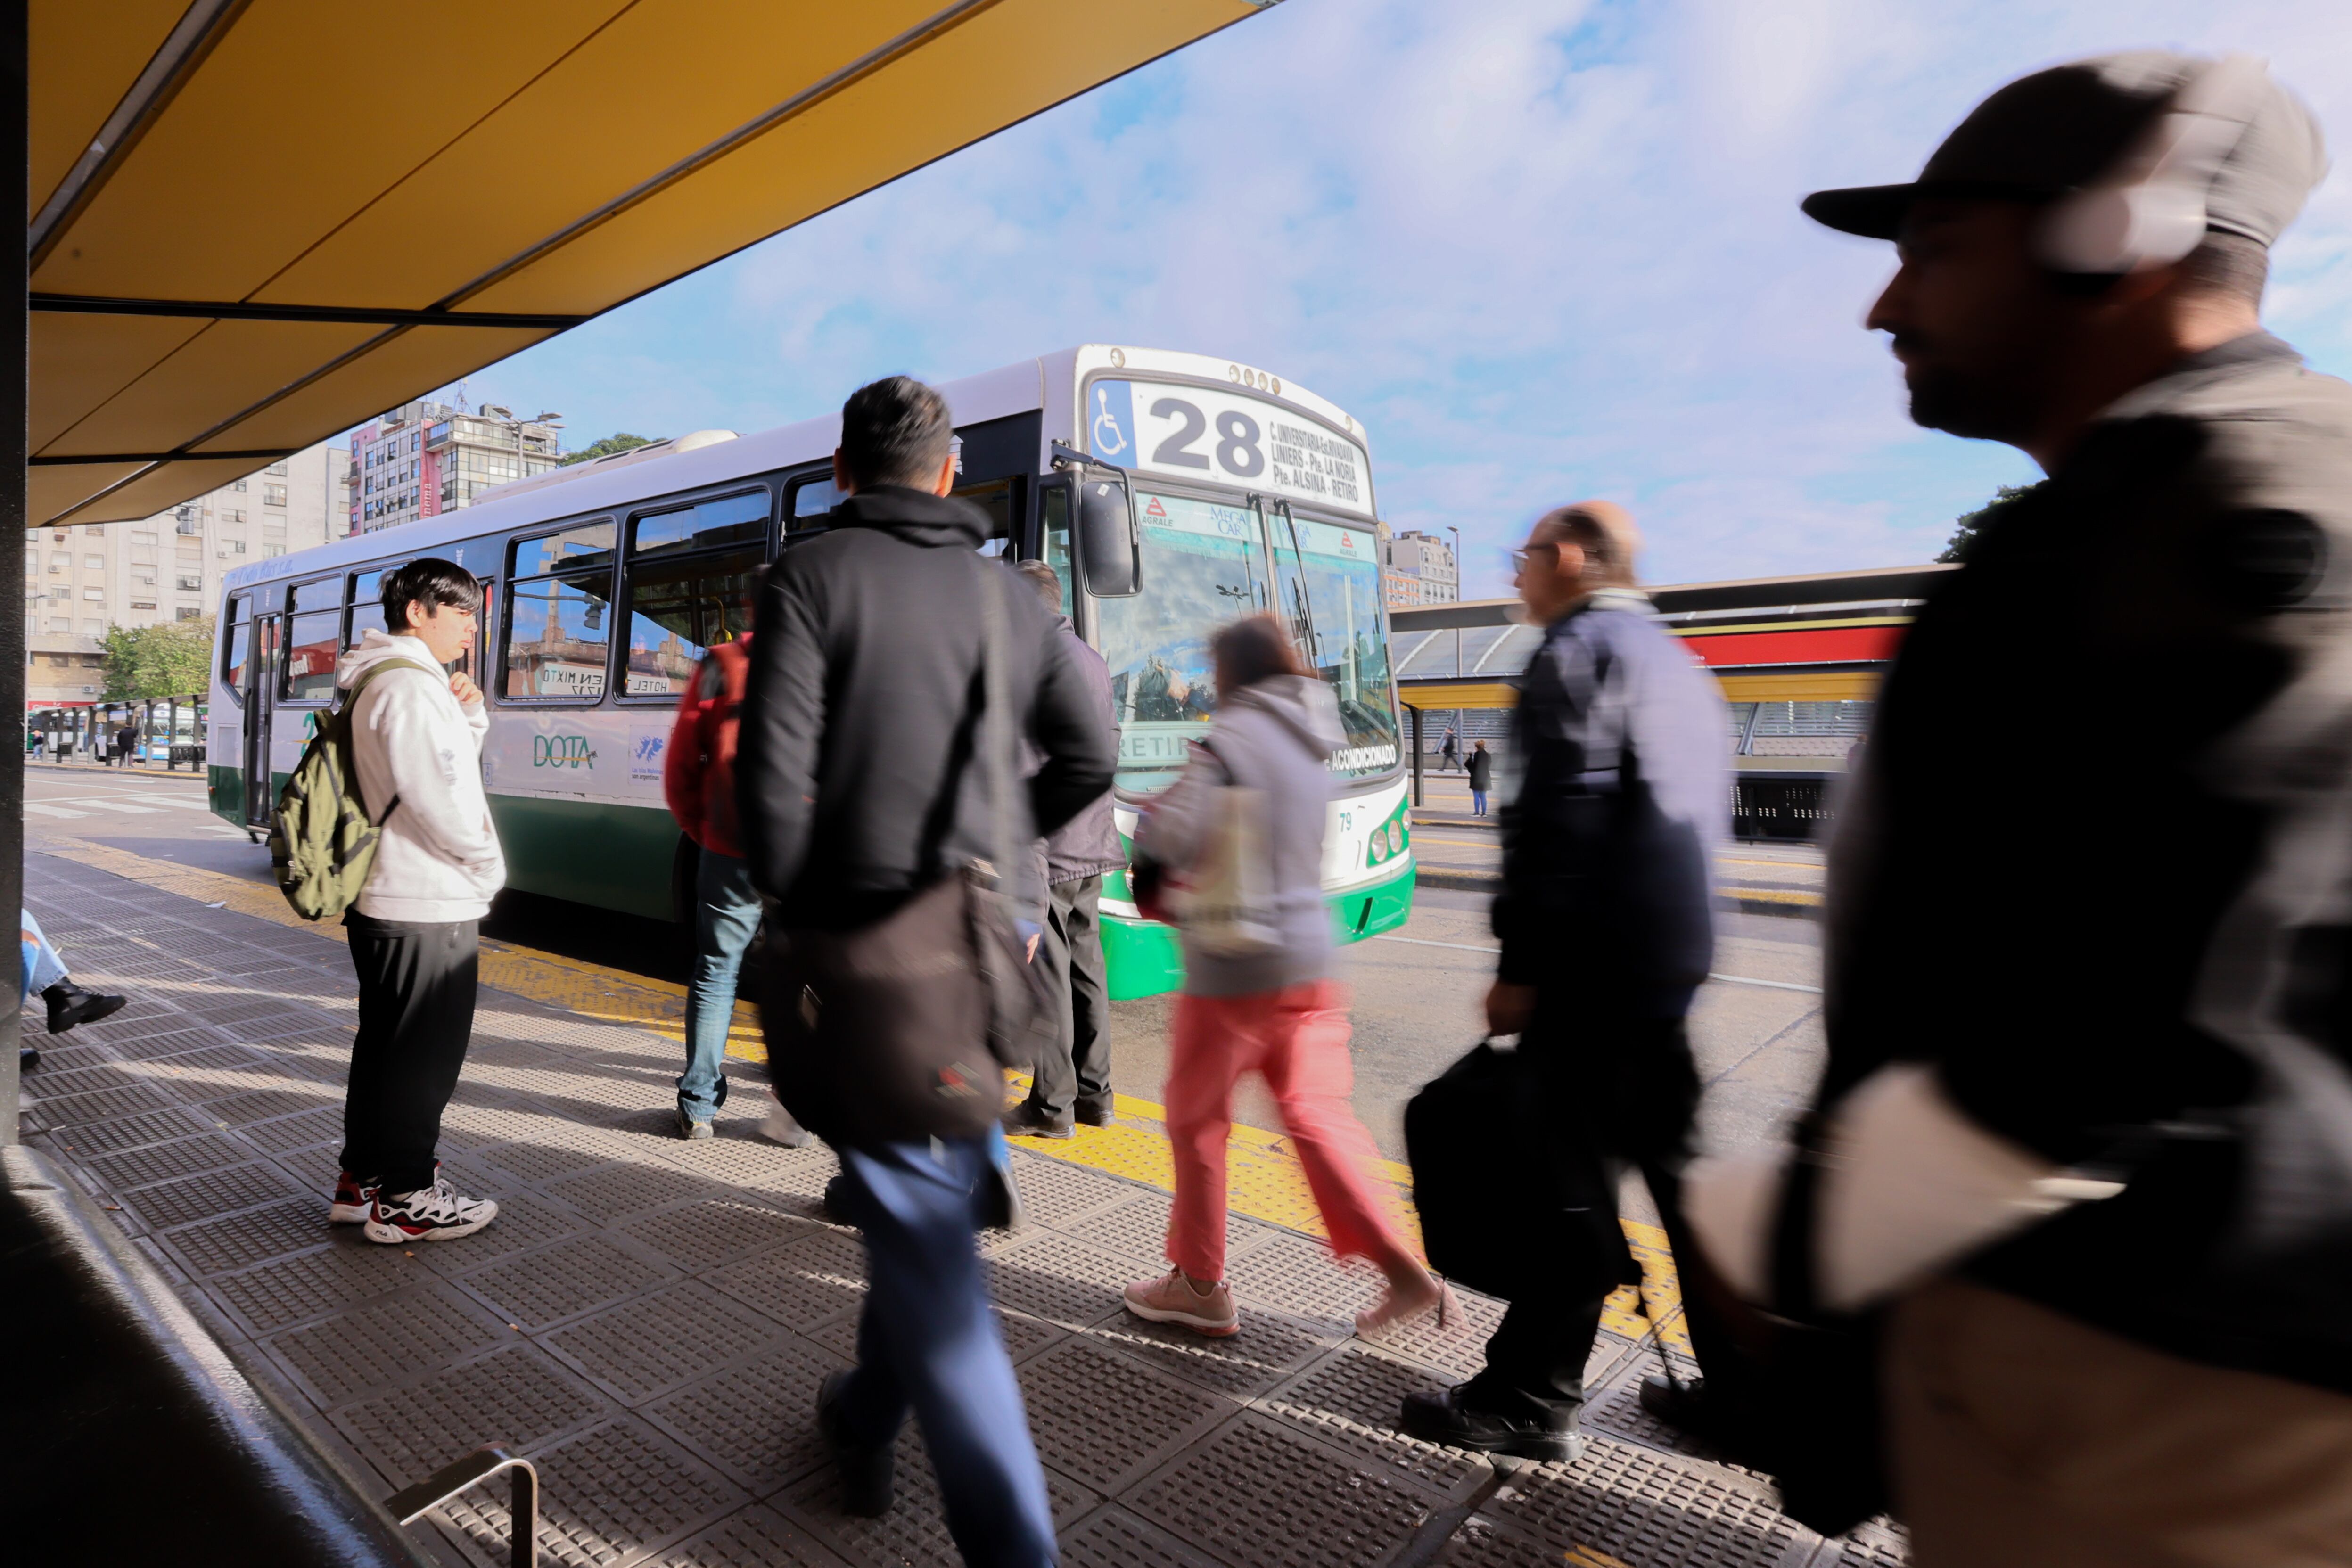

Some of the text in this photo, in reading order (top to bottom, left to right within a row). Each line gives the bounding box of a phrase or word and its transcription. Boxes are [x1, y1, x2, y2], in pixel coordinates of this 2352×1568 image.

[1150, 398, 1265, 477] 28
[1270, 421, 1276, 441] C.
[1271, 443, 1304, 468] LINIERS
[1309, 453, 1324, 474] Pte.
[1324, 457, 1334, 476] LA
[1335, 460, 1357, 484] NORIA
[1274, 464, 1291, 485] Pte.
[1293, 469, 1326, 493] ALSINA
[1332, 479, 1358, 503] RETIRO
[422, 483, 431, 518] inema
[1142, 516, 1173, 527] AGRALE
[1210, 506, 1247, 525] MEGA
[1218, 520, 1244, 536] CAR
[1282, 519, 1312, 538] MGA
[1340, 548, 1357, 558] AGRALE
[534, 735, 593, 769] DOTA
[1332, 744, 1396, 771] ACONDICIONADO
[1340, 812, 1351, 832] 79
